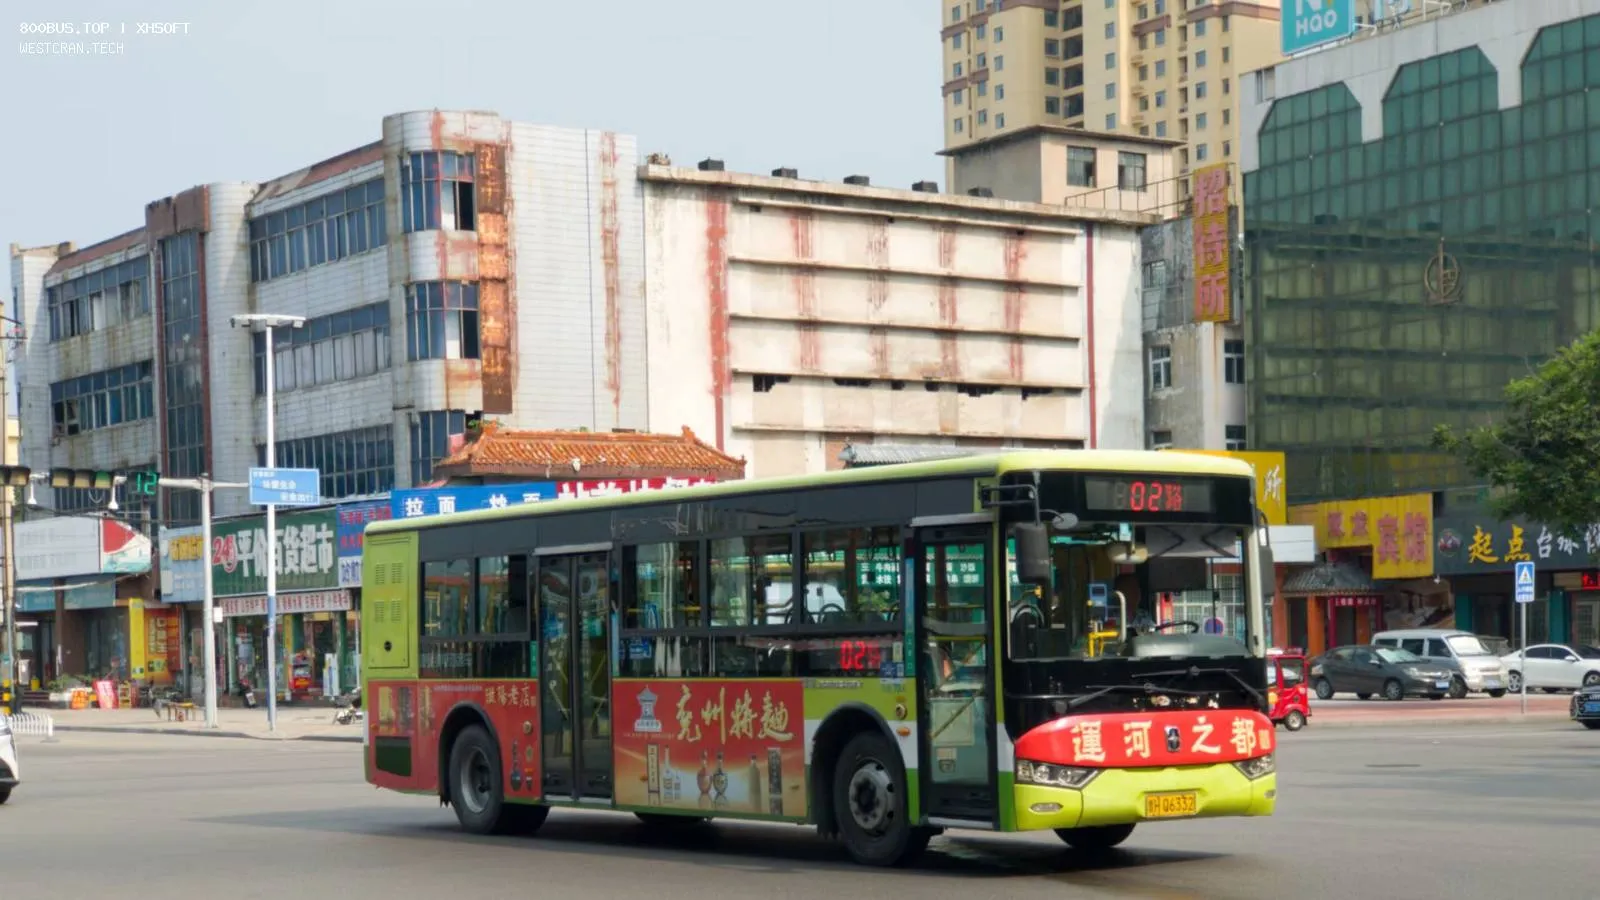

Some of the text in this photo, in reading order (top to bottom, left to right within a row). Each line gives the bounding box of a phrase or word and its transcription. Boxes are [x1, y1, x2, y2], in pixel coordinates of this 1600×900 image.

[136, 472, 157, 496] 12
[1070, 716, 1257, 763] 運河之都
